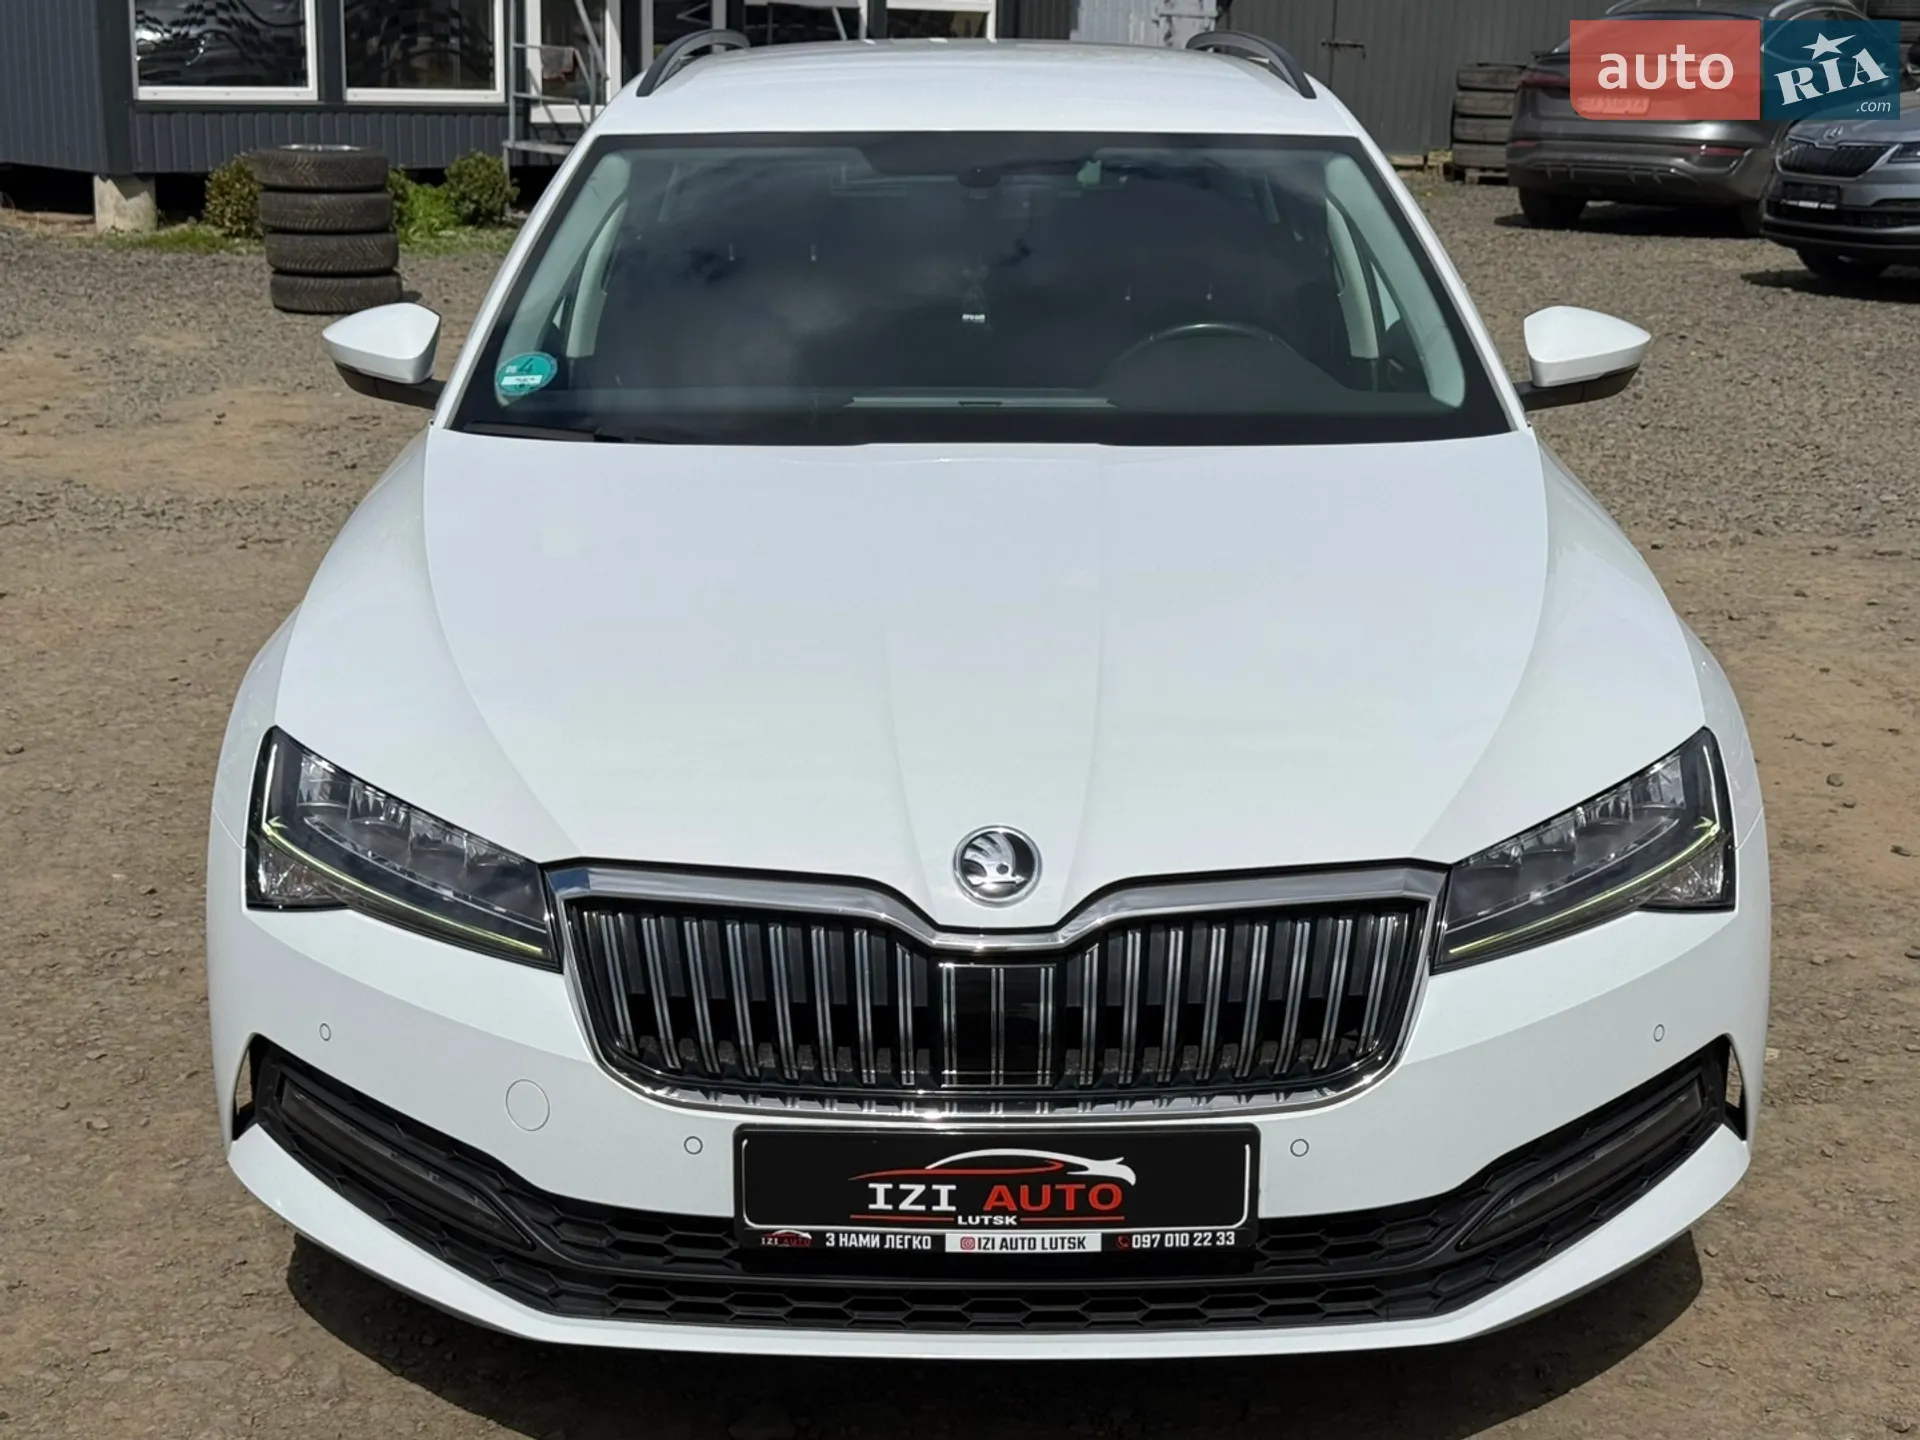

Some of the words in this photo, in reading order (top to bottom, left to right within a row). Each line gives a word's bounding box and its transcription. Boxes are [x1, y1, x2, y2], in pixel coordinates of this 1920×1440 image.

[518, 357, 535, 373] 4
[868, 1183, 957, 1211] IZI
[982, 1183, 1123, 1212] AUTO
[957, 1215, 1018, 1225] LUTSK
[839, 1233, 880, 1248] НАМИ
[884, 1235, 932, 1249] ЛЕГКО
[977, 1236, 995, 1250] IZI
[999, 1236, 1036, 1250] AUTO
[1041, 1236, 1087, 1250] LUTSK
[1132, 1233, 1161, 1249] 097
[1164, 1232, 1190, 1248] 010
[1193, 1231, 1213, 1247] 22
[1216, 1231, 1235, 1246] 33
